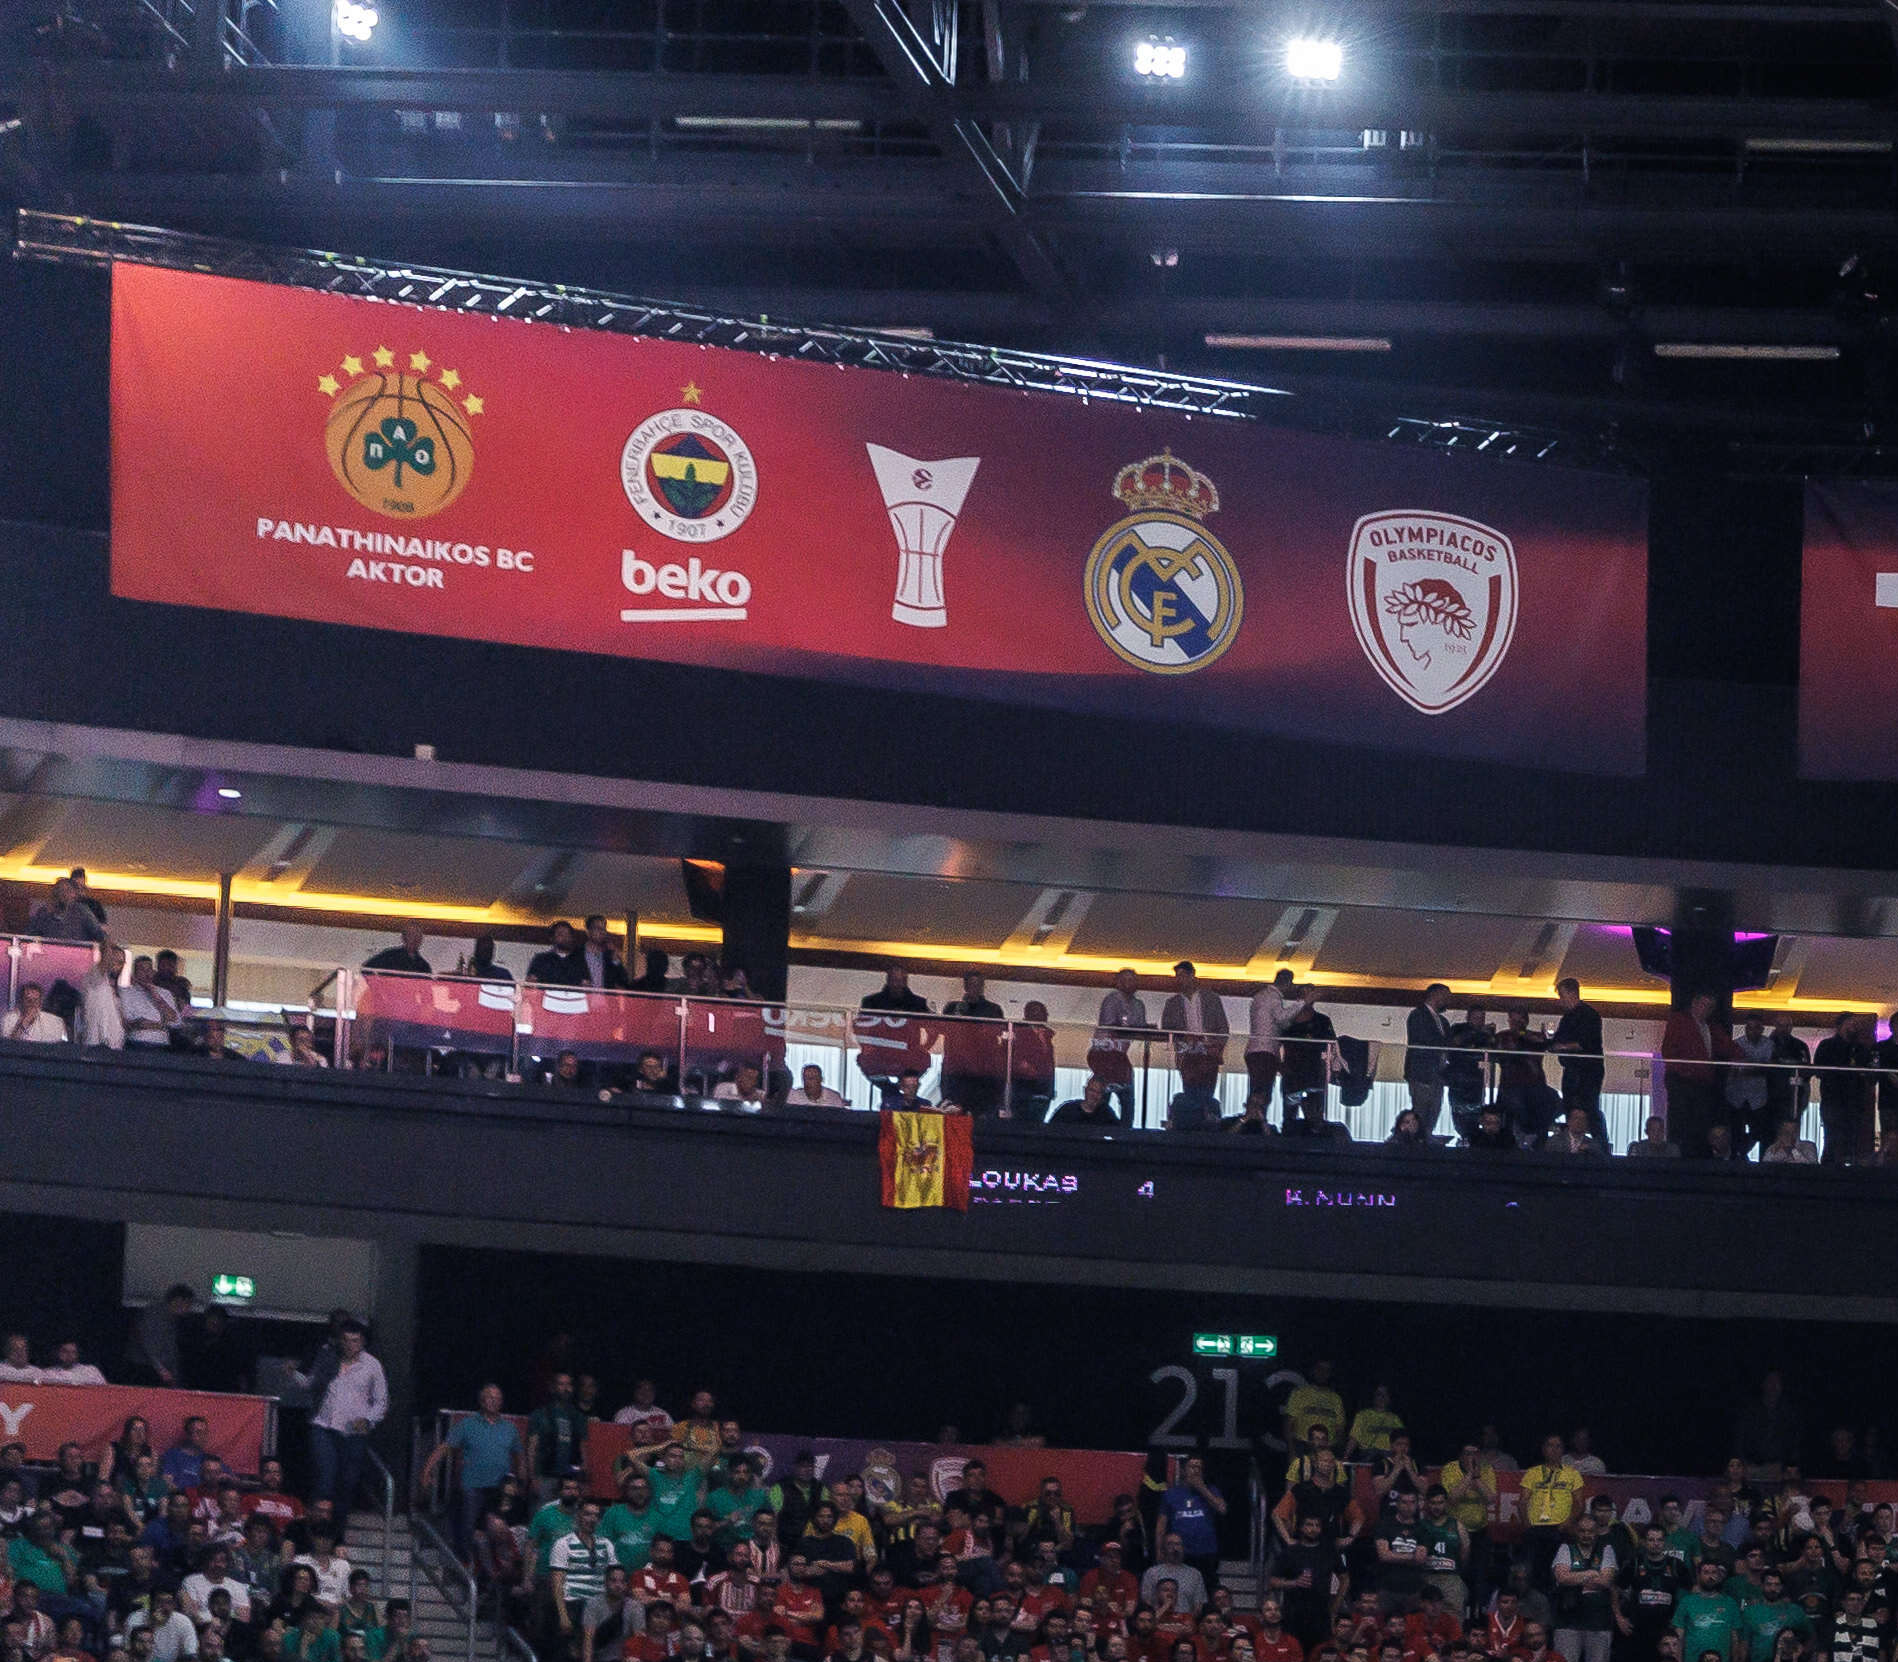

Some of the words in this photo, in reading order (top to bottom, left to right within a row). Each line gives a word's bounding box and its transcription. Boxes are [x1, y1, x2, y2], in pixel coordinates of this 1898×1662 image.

[256, 517, 492, 570] PANATHINAIKOS
[496, 546, 535, 574] BC
[1369, 526, 1498, 565] OLYMPIACOS
[1387, 548, 1479, 576] BASKETBALL
[346, 556, 446, 590] AKTOR
[621, 549, 752, 610] beko
